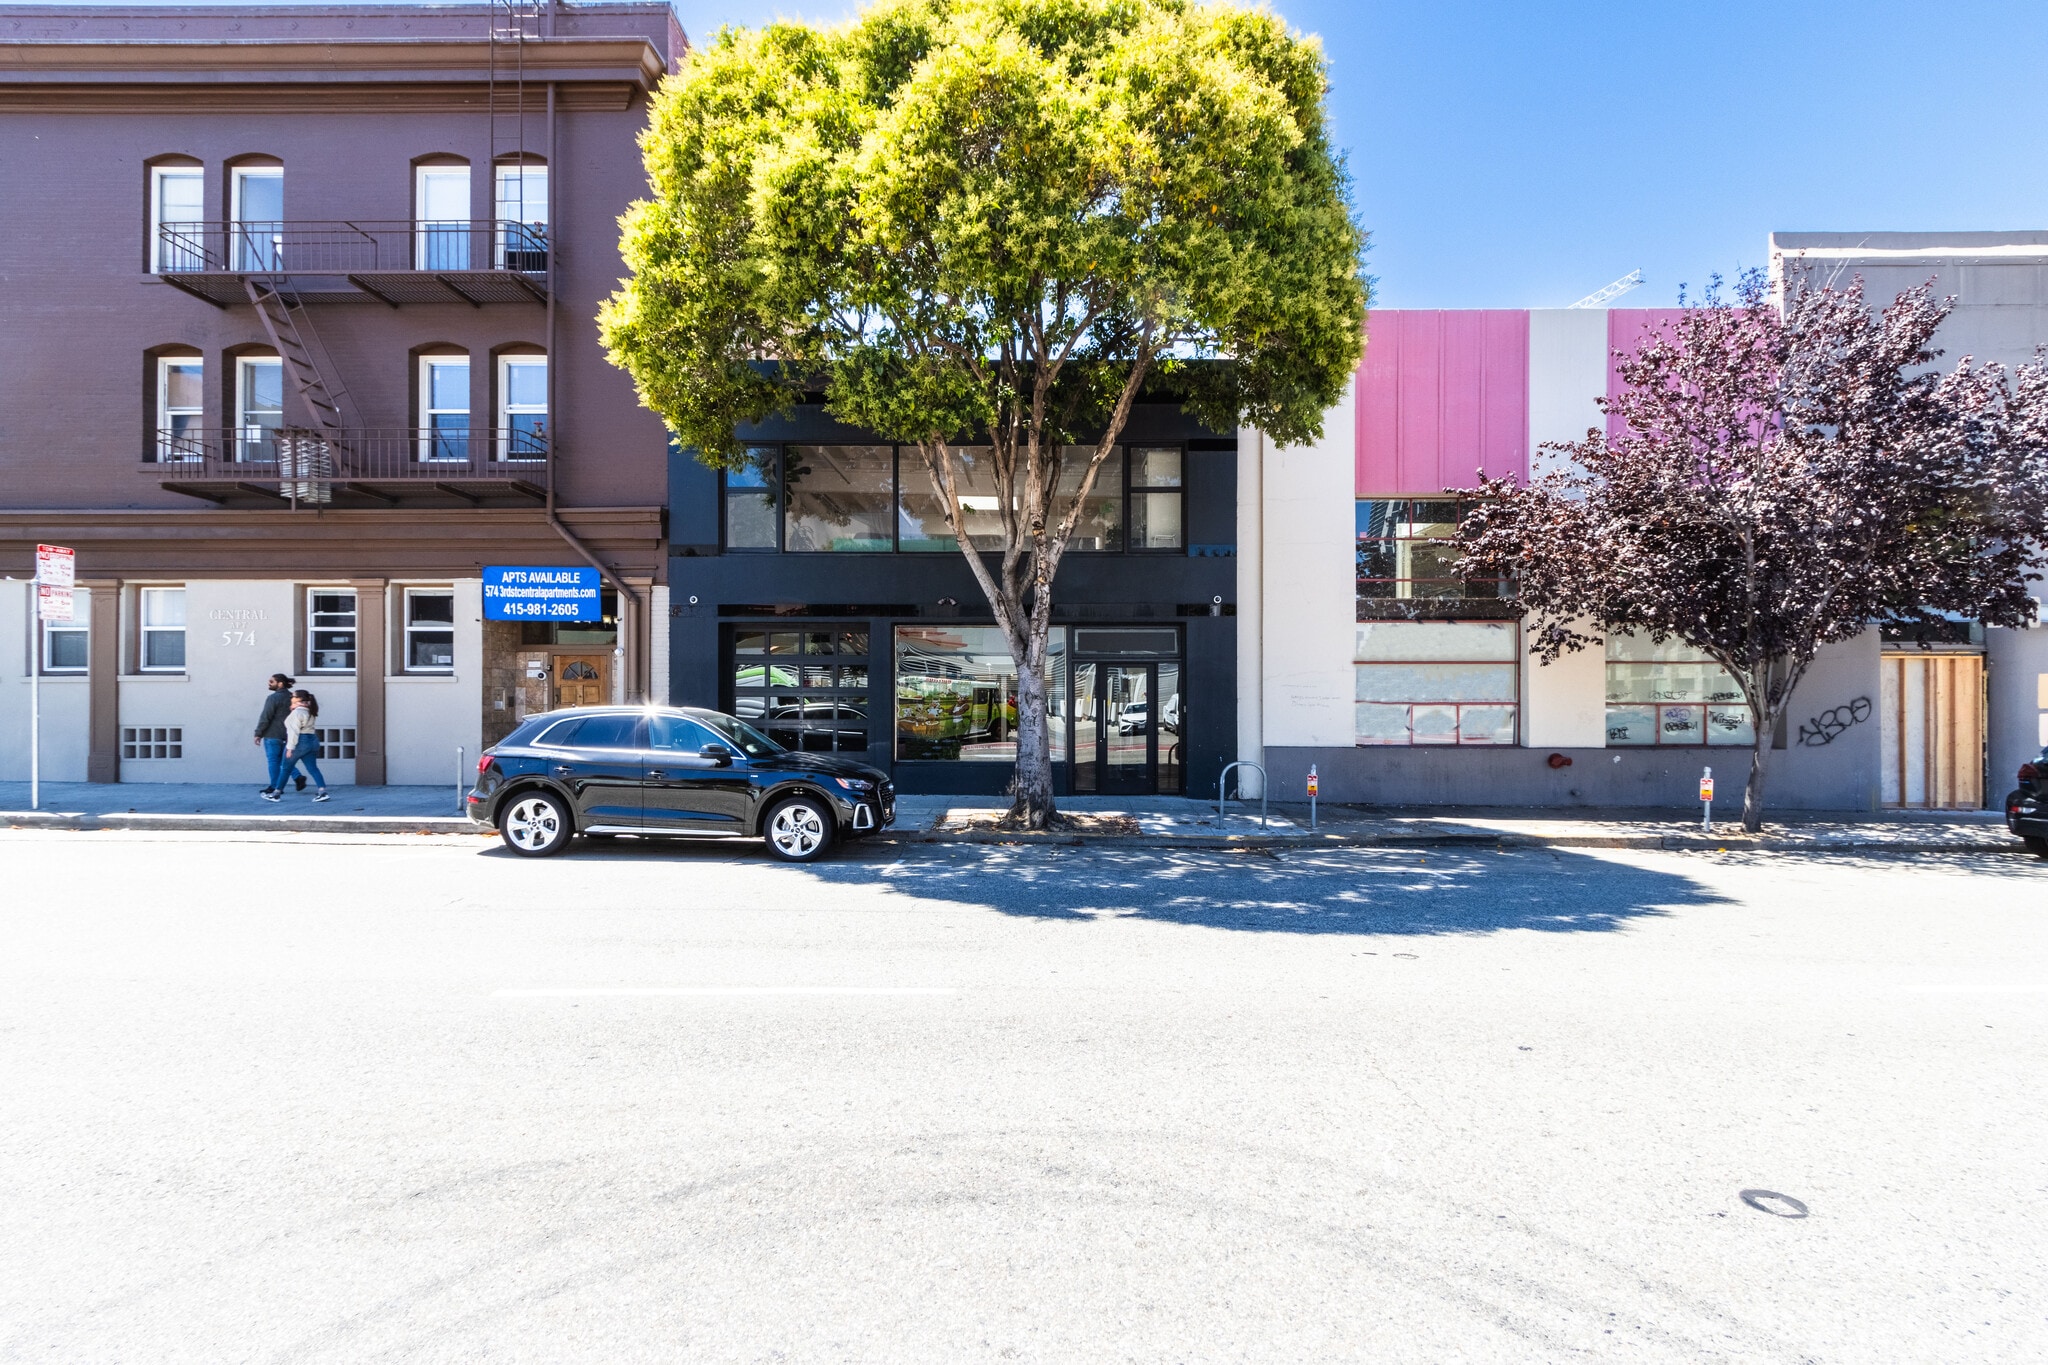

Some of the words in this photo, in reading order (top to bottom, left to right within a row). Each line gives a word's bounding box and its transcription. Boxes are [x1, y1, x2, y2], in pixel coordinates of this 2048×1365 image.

[40, 551, 49, 559] NO
[502, 572, 526, 583] APTS
[528, 572, 580, 583] AVAILABLE
[40, 587, 50, 596] NO
[51, 589, 73, 597] PARKING
[485, 585, 499, 597] 574
[500, 585, 596, 600] 3rdstcentralapartments.com
[209, 609, 270, 620] CENTRAL
[503, 602, 579, 616] 415-981-2605
[222, 630, 256, 646] 574
